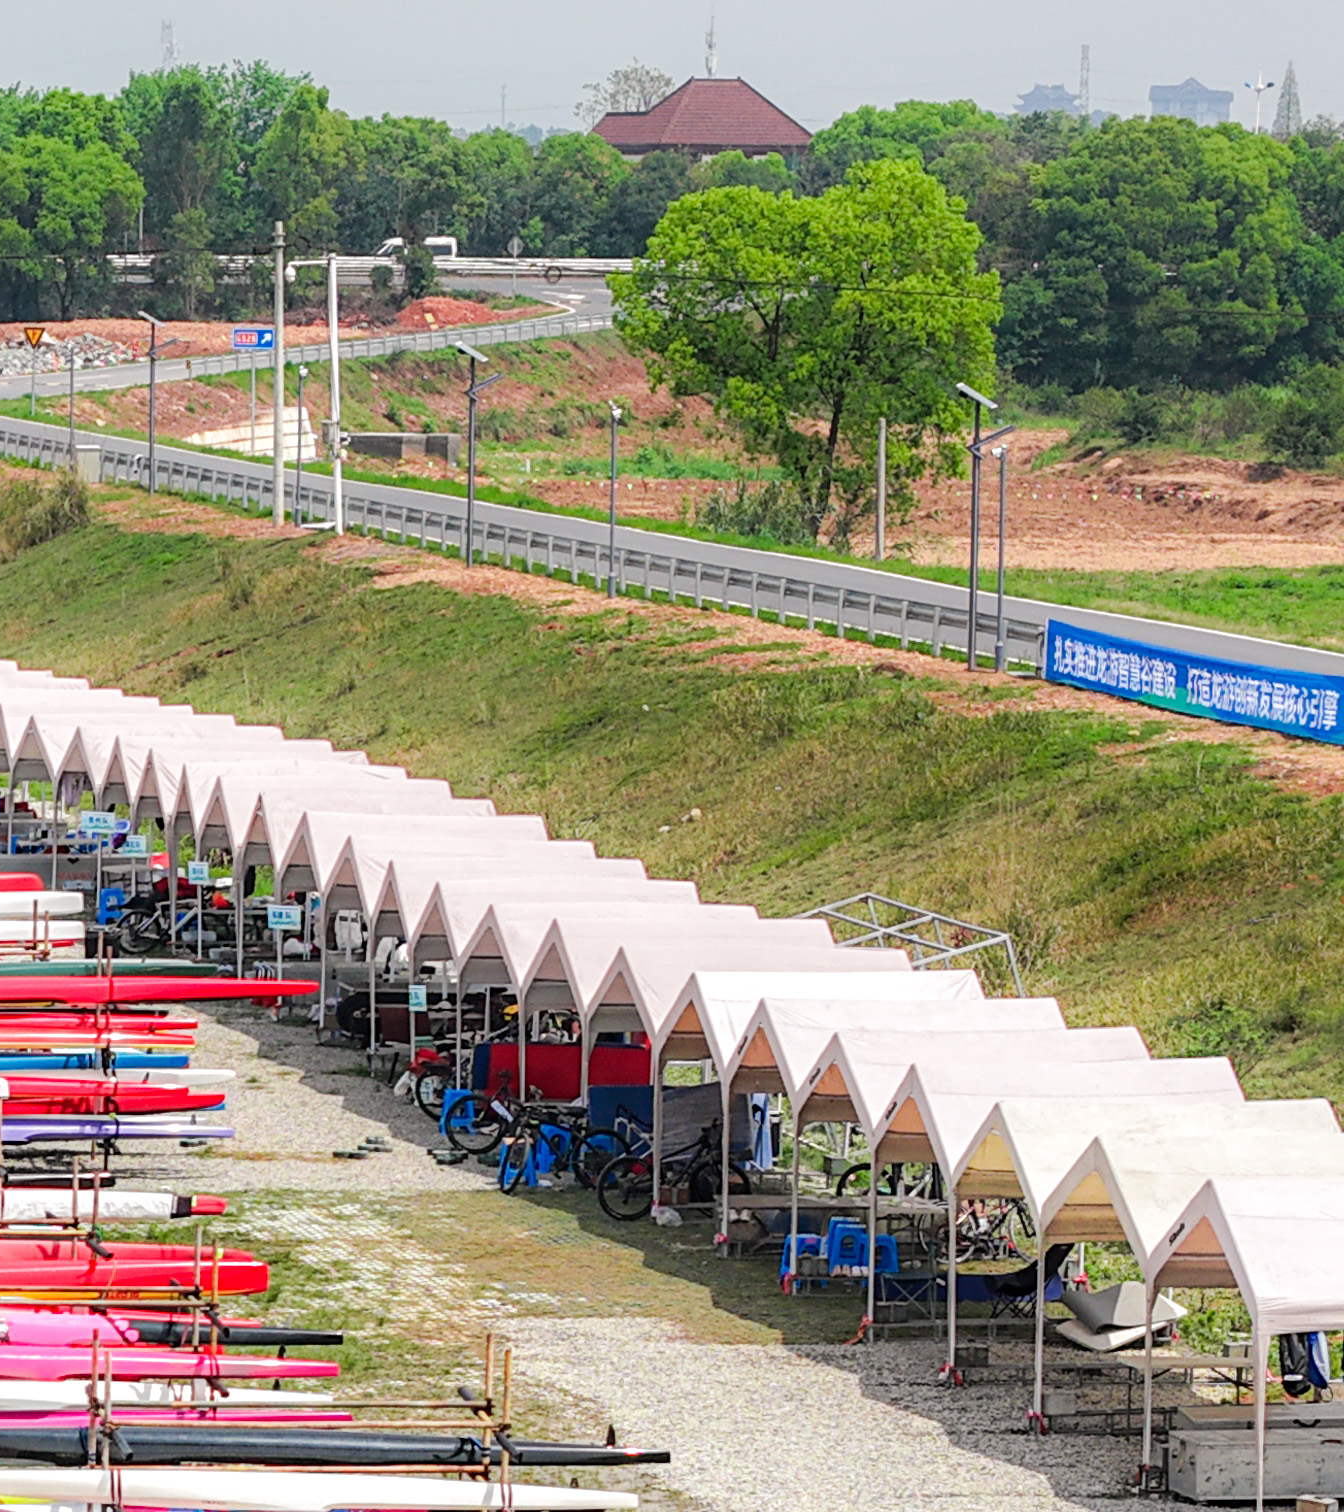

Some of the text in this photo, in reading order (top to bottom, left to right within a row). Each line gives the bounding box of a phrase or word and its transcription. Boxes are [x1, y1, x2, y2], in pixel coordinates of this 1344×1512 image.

[1053, 634, 1341, 731] 扎实推进龙游智慧谷建设 打造龙游创新发展核心引擎
